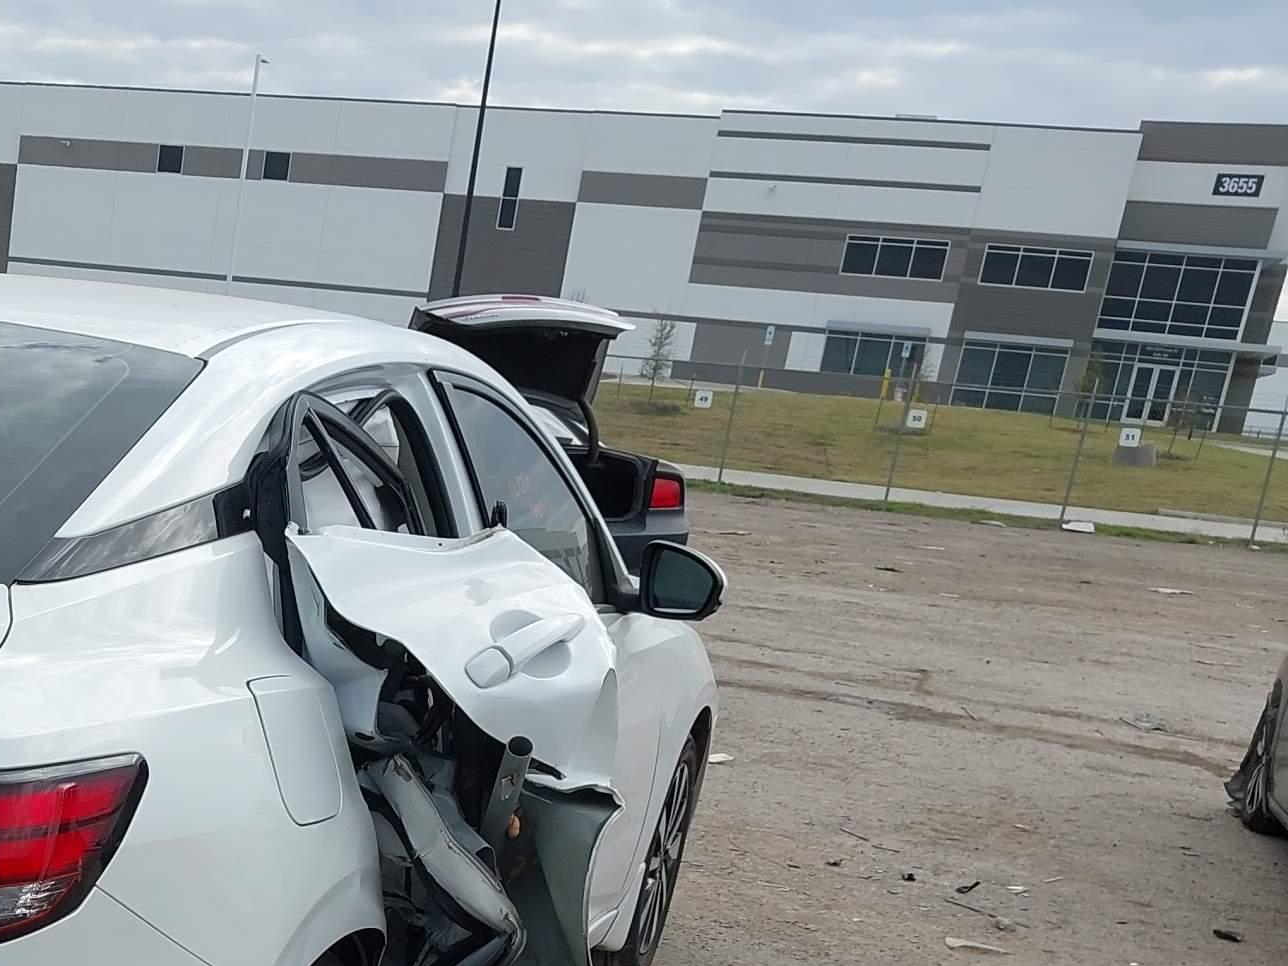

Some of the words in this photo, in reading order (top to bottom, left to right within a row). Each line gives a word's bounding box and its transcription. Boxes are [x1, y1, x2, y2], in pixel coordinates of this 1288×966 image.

[1218, 176, 1259, 194] 3655
[912, 415, 922, 423] 50
[1124, 433, 1136, 441] 51
